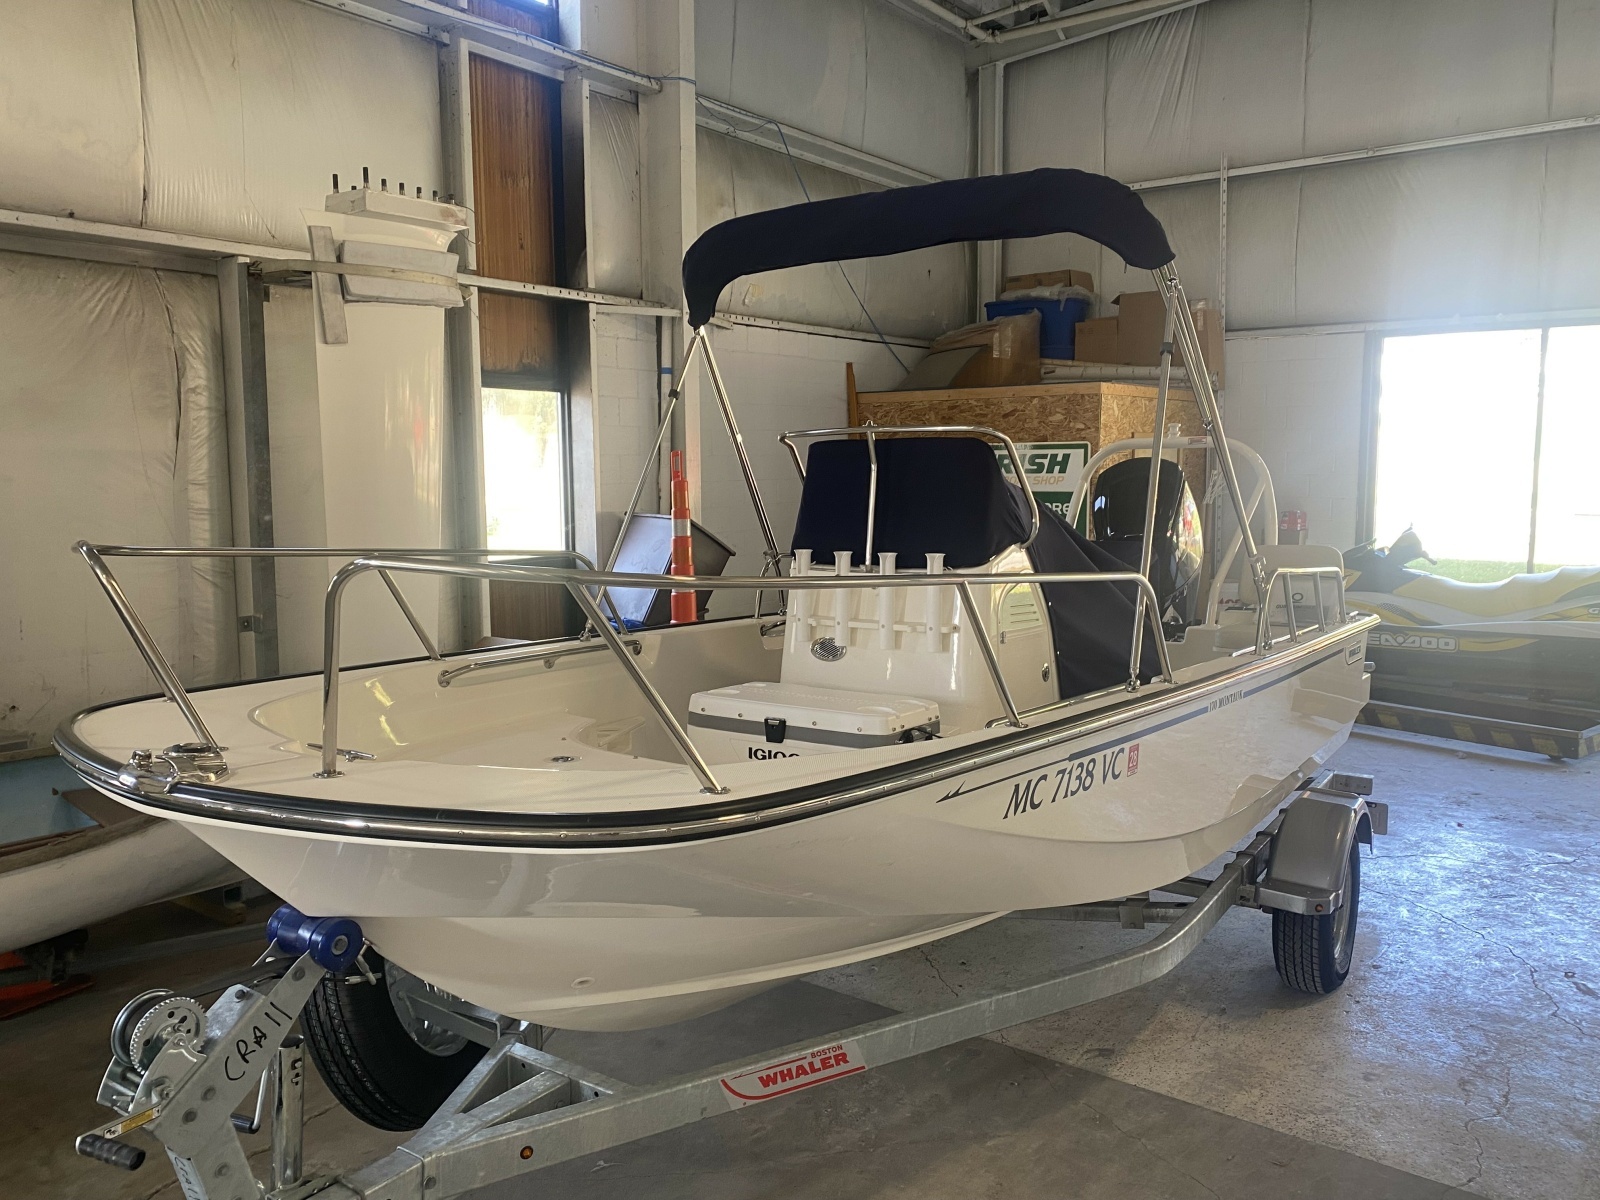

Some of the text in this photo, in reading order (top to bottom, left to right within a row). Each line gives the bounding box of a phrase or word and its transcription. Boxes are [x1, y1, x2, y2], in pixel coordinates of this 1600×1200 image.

[996, 453, 1071, 474] RISH
[1032, 476, 1065, 485] SHOP
[748, 747, 800, 761] IGLO
[1002, 747, 1125, 820] MC 7138 VC
[810, 1044, 844, 1059] BOSTON
[757, 1051, 850, 1089] WHALER
